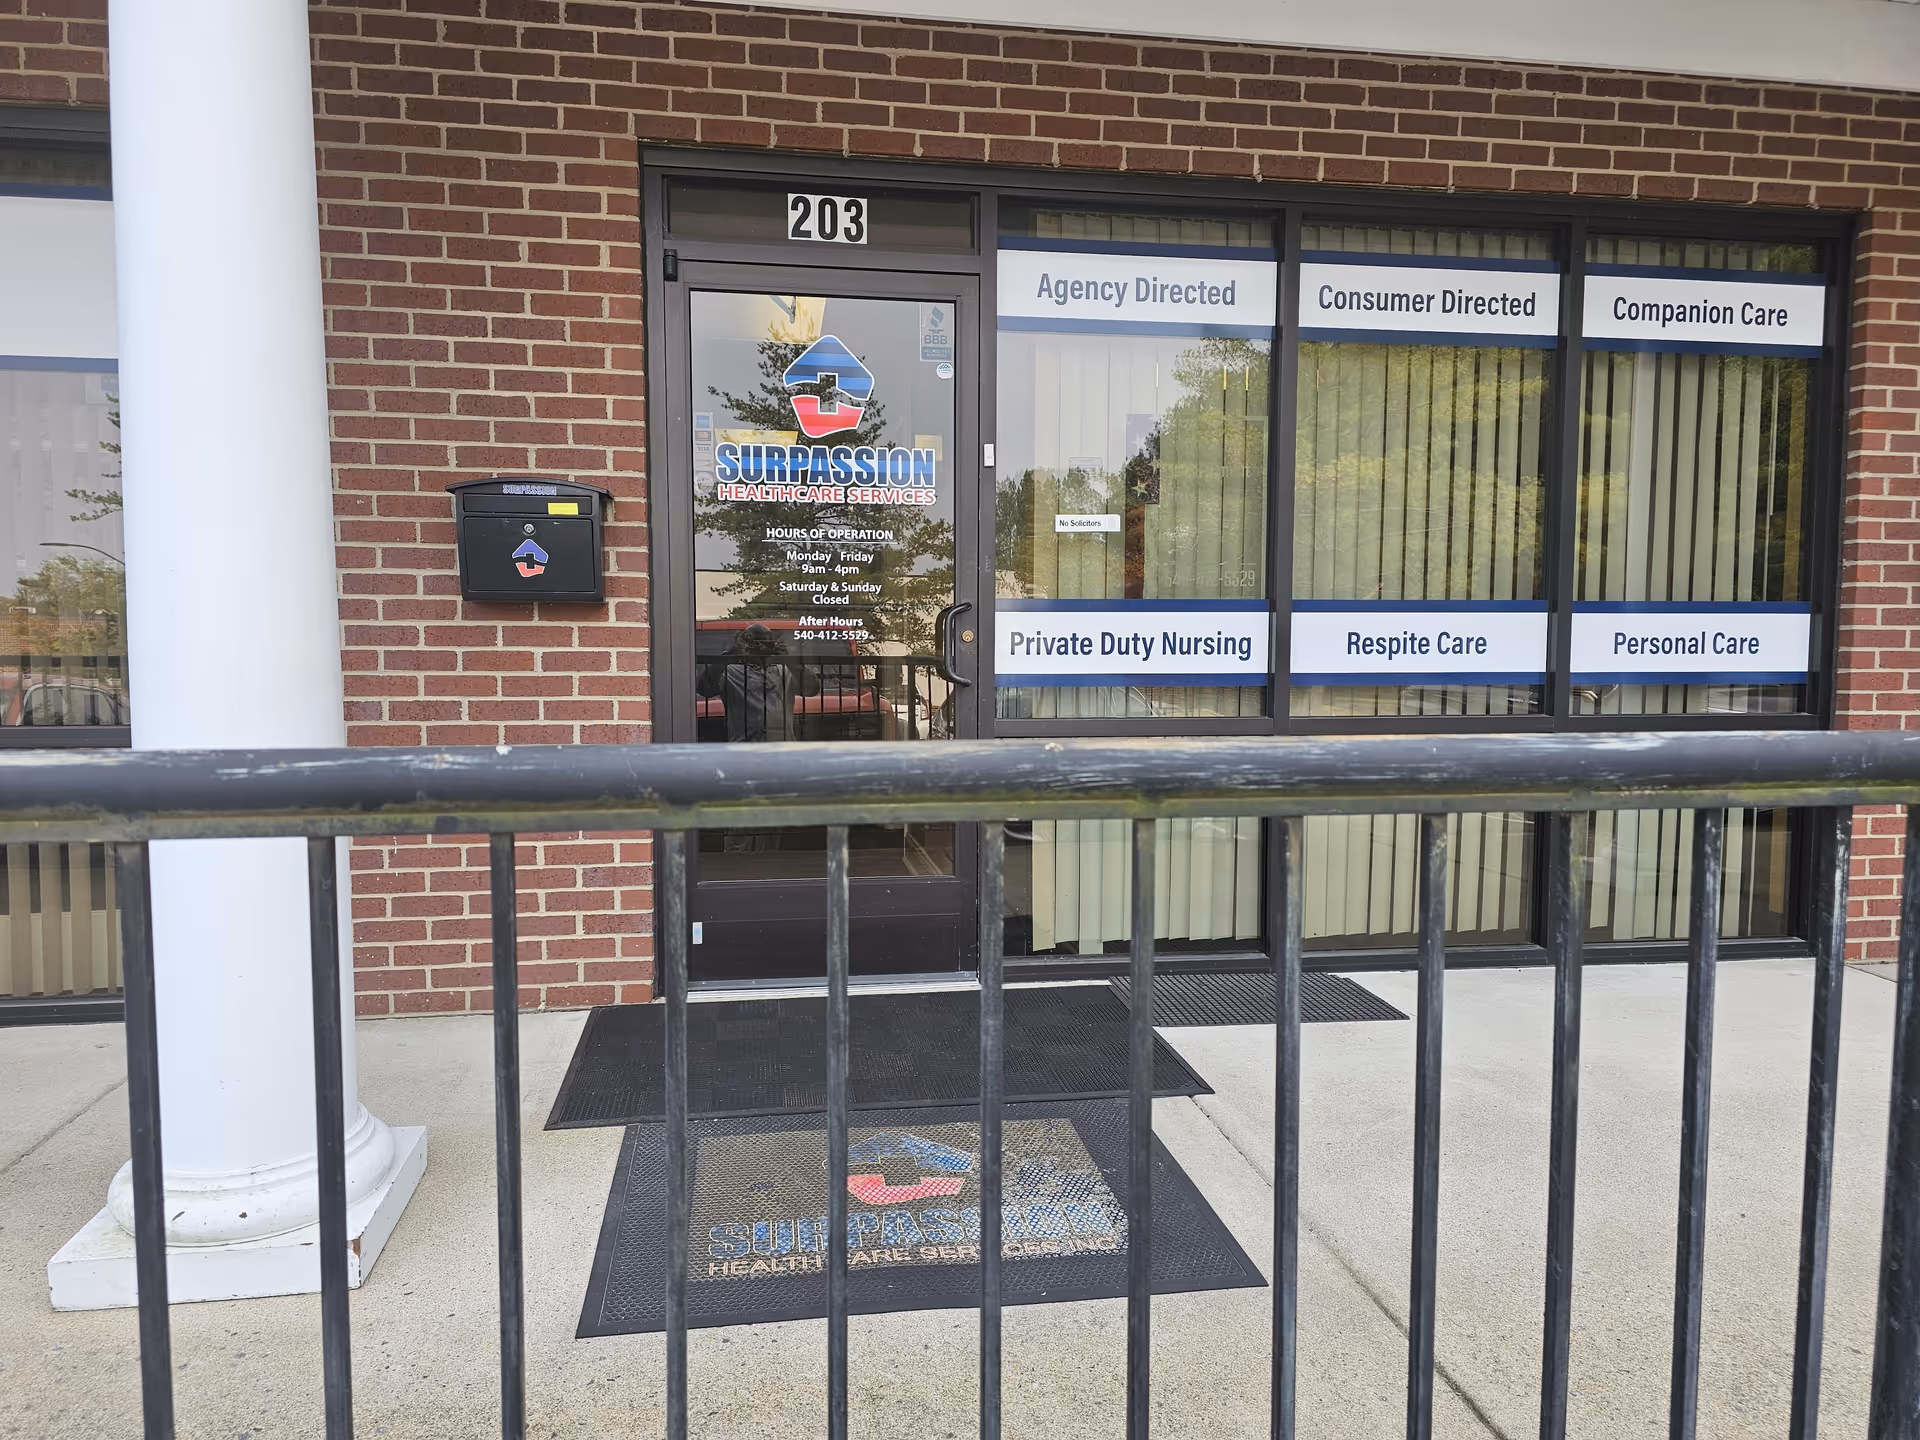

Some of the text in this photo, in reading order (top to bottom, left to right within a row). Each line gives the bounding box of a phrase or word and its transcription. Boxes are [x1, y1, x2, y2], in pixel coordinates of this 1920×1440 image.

[790, 195, 864, 243] 203
[1037, 273, 1236, 307] Agency Directed
[1318, 284, 1536, 316] Consumer Directed
[1613, 296, 1788, 328] Companion Care
[924, 334, 948, 345] BBB
[716, 442, 936, 488] SURPASSION
[719, 484, 937, 505] HEALTHCARE SERVICES
[1059, 519, 1101, 527] No Solicitors
[766, 528, 894, 540] HOURS OF OPERATION
[786, 551, 874, 564] Monday Friday
[802, 565, 826, 574] 9am
[834, 565, 860, 577] 4pm
[779, 581, 882, 594] Saturday & Sunday
[812, 594, 850, 605] Closed
[799, 616, 864, 627] After Hours
[793, 630, 869, 640] 540-412-5529
[1613, 631, 1760, 655] Personal Care
[1010, 630, 1252, 662] Private Duty Nursing
[1346, 630, 1487, 661] Respite Care
[920, 1240, 1060, 1260] SERCES
